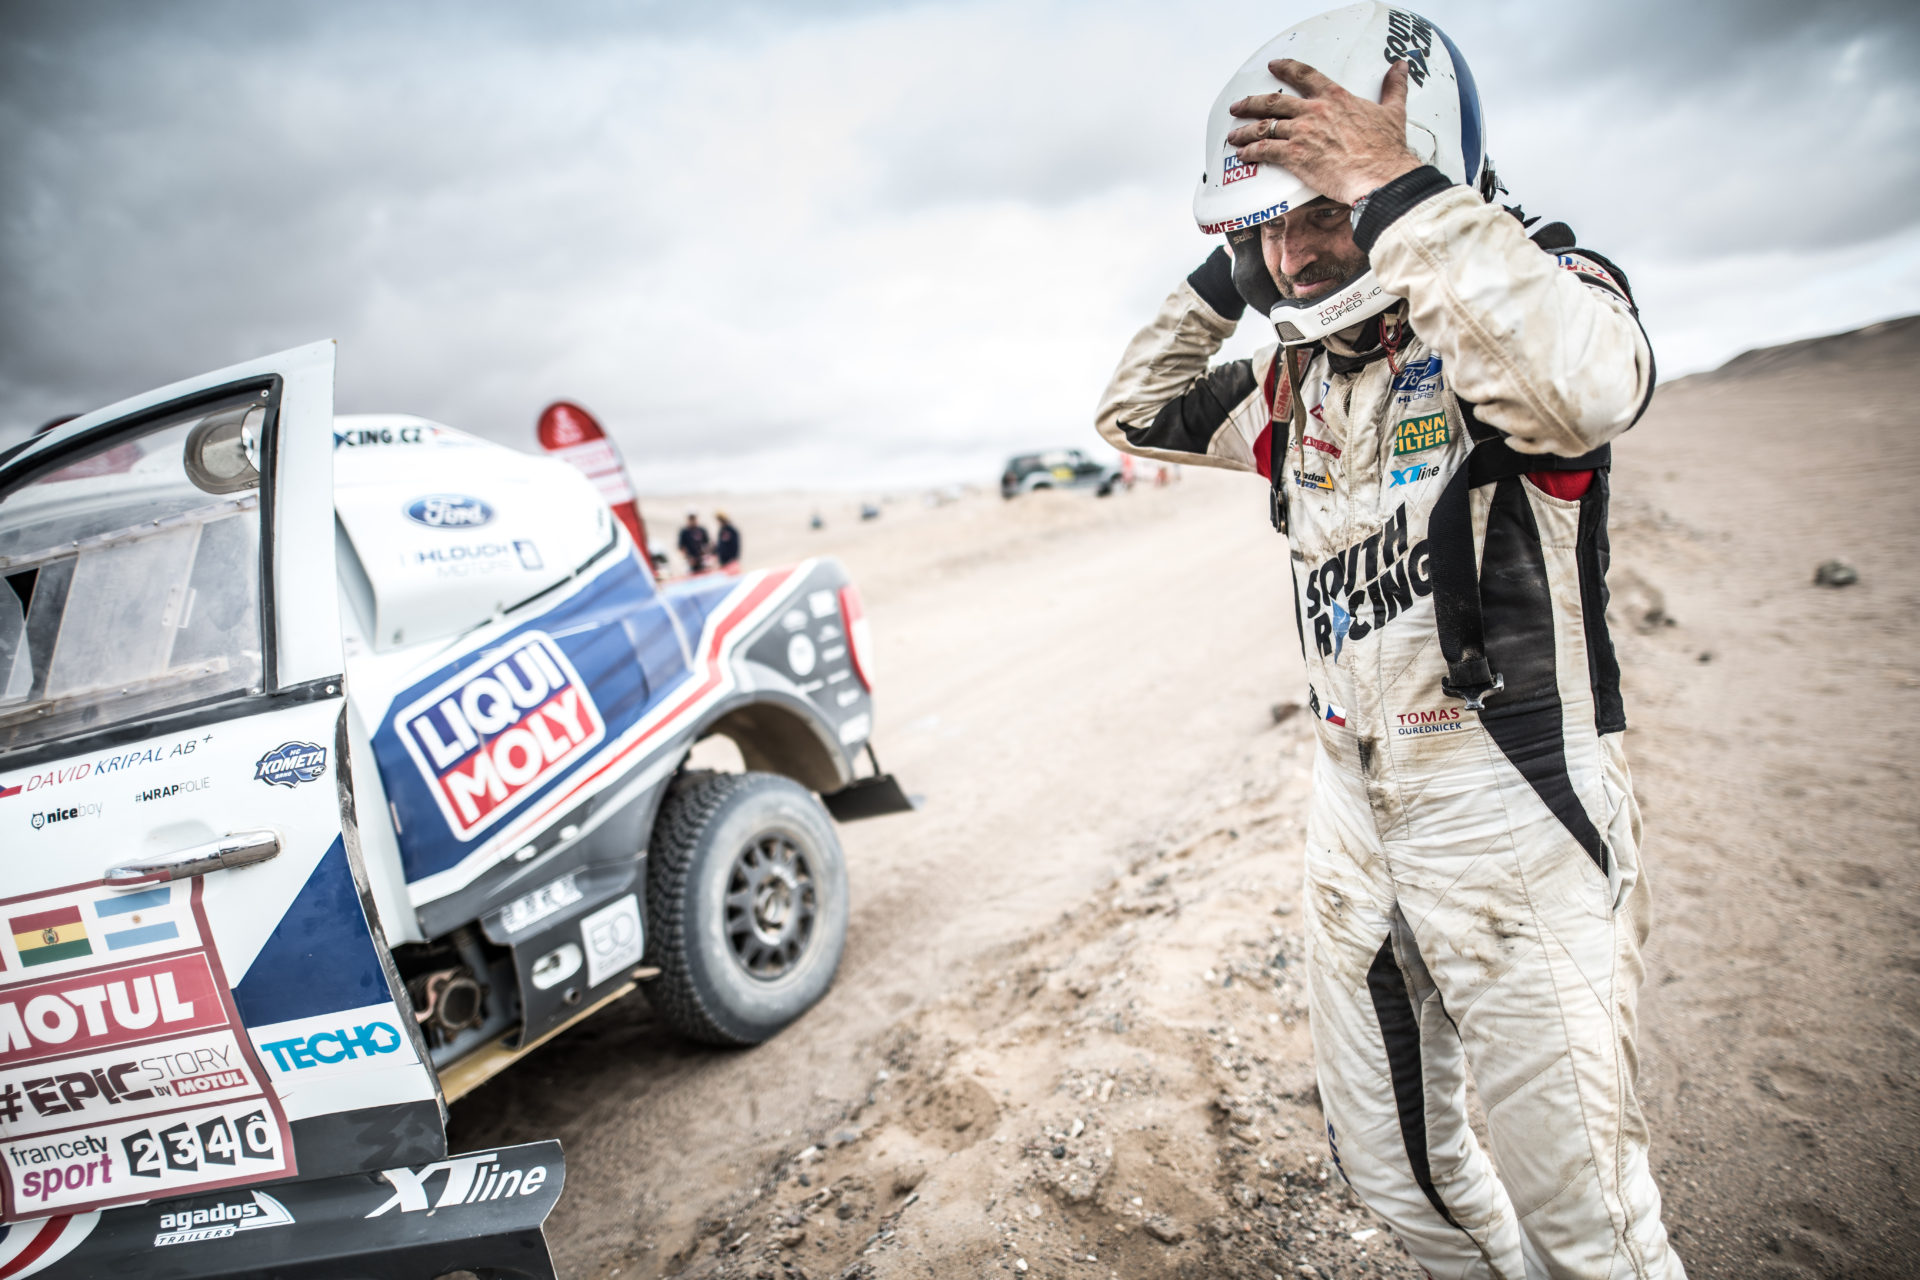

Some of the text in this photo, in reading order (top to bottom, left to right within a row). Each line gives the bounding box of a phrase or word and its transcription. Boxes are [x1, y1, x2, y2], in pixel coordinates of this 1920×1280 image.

[1384, 9, 1411, 65] SOUTH
[1224, 164, 1256, 184] MOLY
[1318, 291, 1363, 319] TOMAS
[1395, 430, 1446, 452] ILTER
[1389, 462, 1440, 489] XTline
[424, 498, 487, 526] Ford
[1307, 502, 1409, 619] SOUTH
[412, 641, 566, 770] LIQUI
[1397, 707, 1461, 726] TOMAS
[1398, 722, 1462, 736] OUREDNICEK
[26, 763, 92, 792] DAVID
[94, 746, 164, 776] KRIPAL
[259, 749, 325, 777] KOMETA
[445, 687, 586, 824] MOLY
[135, 776, 211, 803] #WRAPFOLIE
[47, 801, 104, 824] niceboy
[260, 1021, 402, 1073] TECHO
[156, 1075, 245, 1097] by MOTUL
[10, 1135, 108, 1167] francetv
[22, 1153, 113, 1200] sport
[364, 1153, 547, 1219] XTline
[160, 1202, 259, 1232] agados
[158, 1228, 232, 1245] TRAILERS
